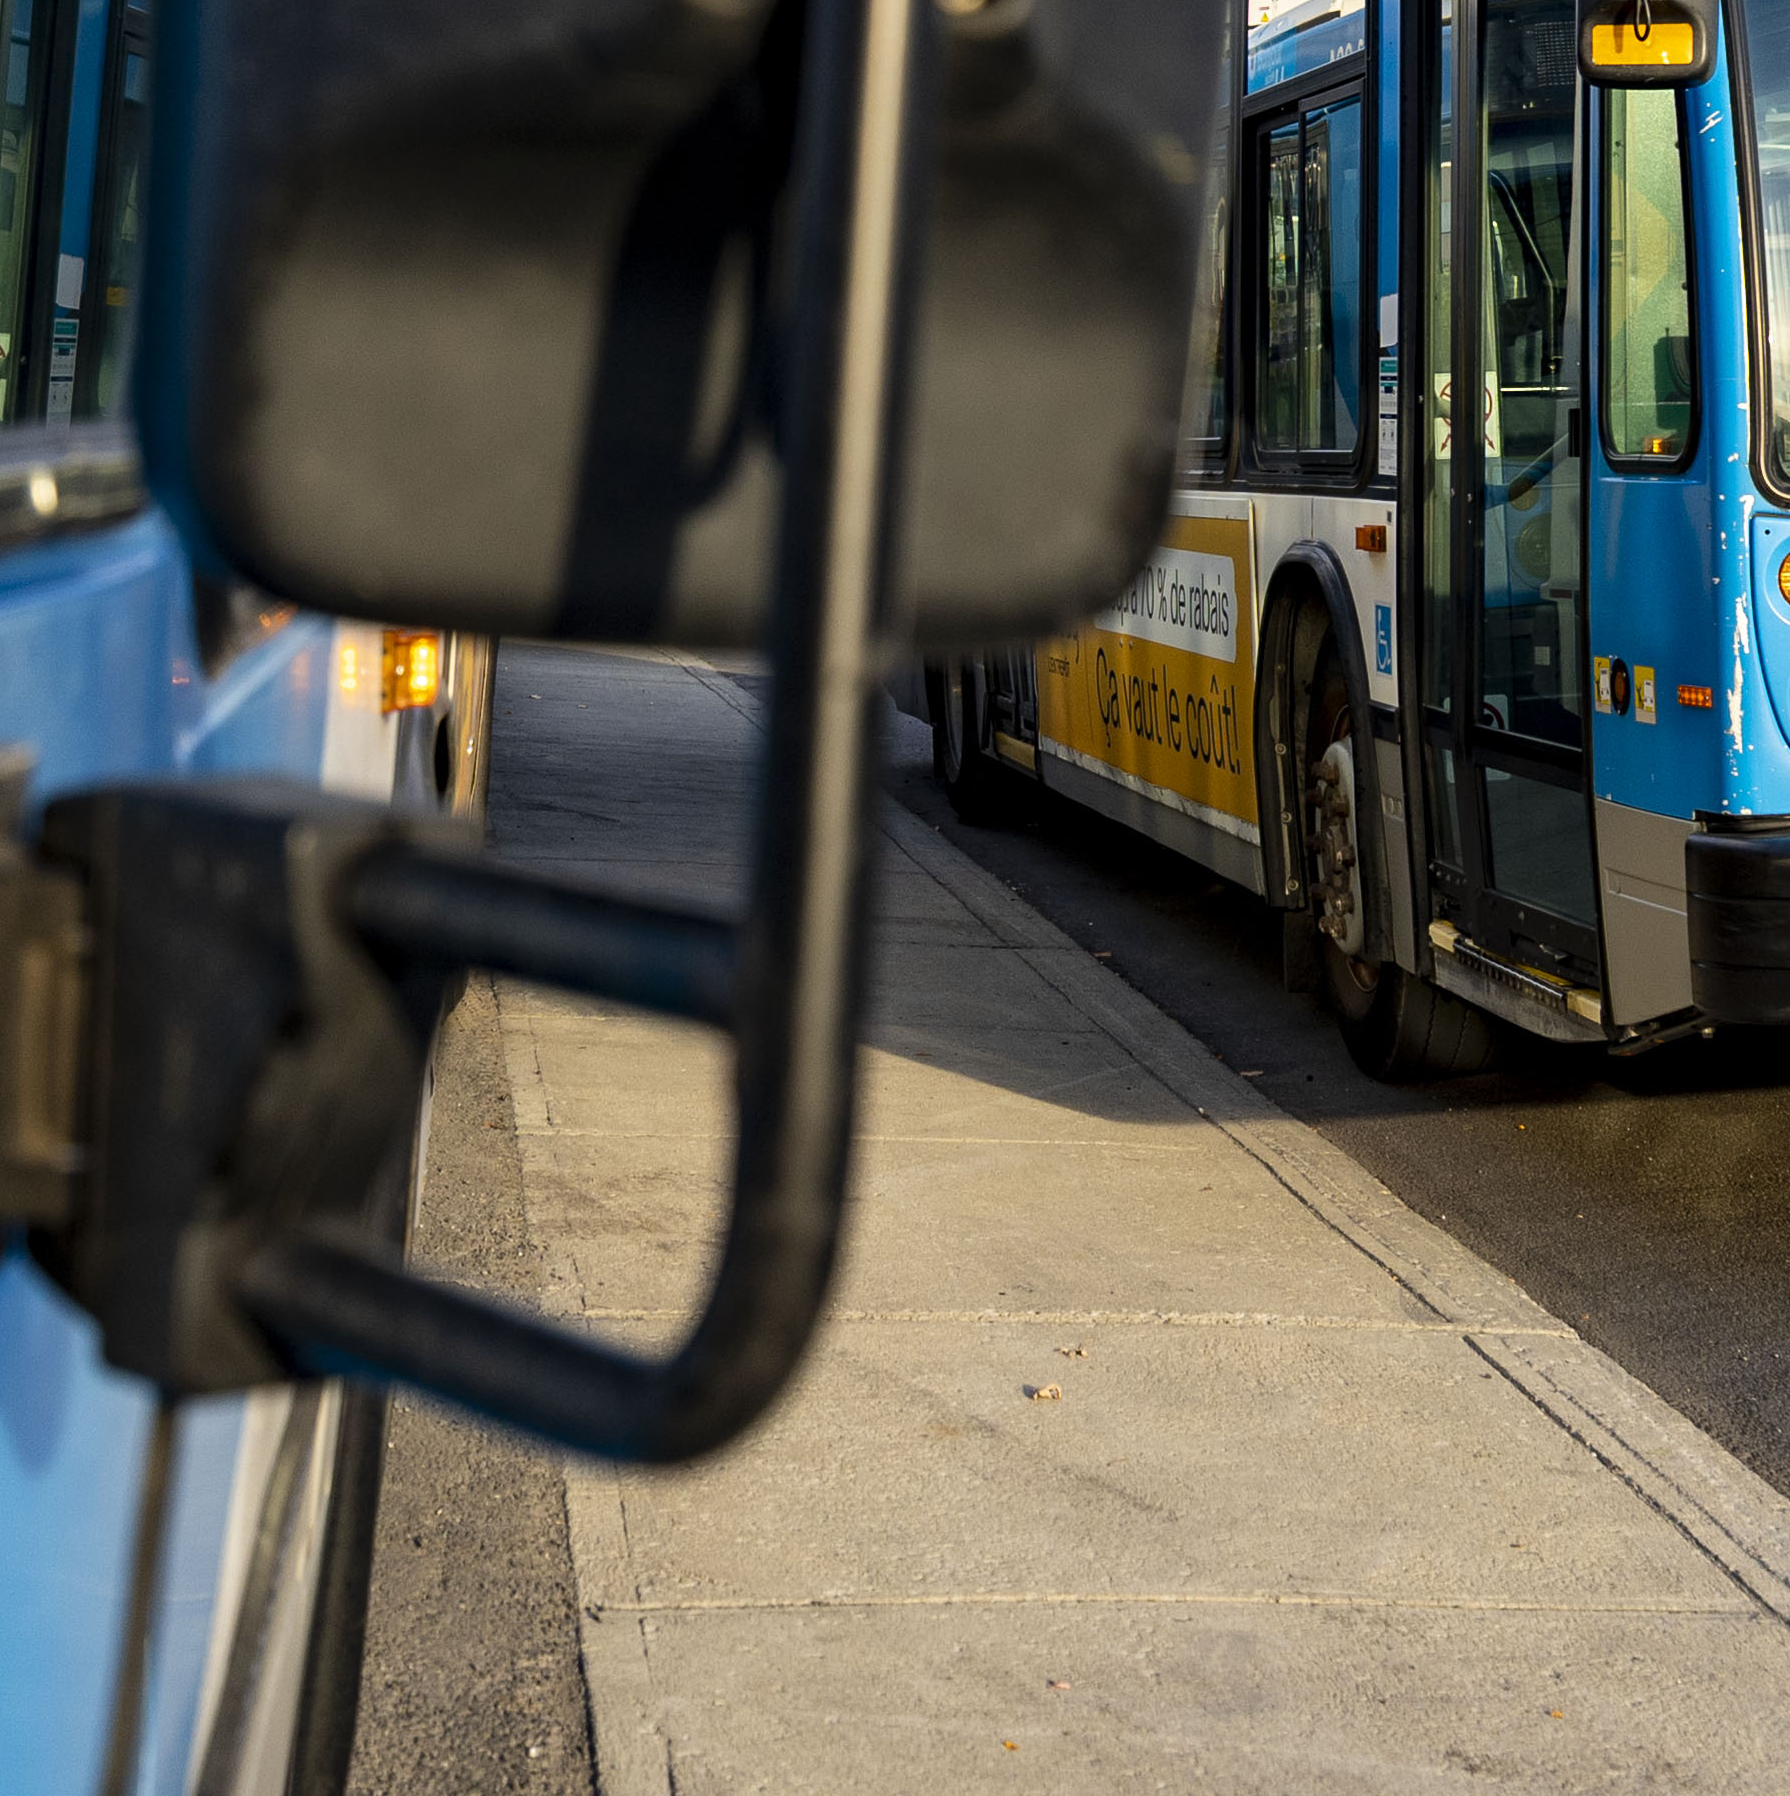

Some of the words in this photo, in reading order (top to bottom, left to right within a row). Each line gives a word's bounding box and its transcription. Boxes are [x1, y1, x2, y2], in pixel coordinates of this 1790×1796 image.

[1170, 568, 1187, 628] de
[1189, 572, 1230, 638] rabais
[1096, 647, 1121, 749] Ça
[1122, 666, 1162, 746] vaut
[1162, 663, 1182, 753] le
[1185, 673, 1241, 776] coût!
